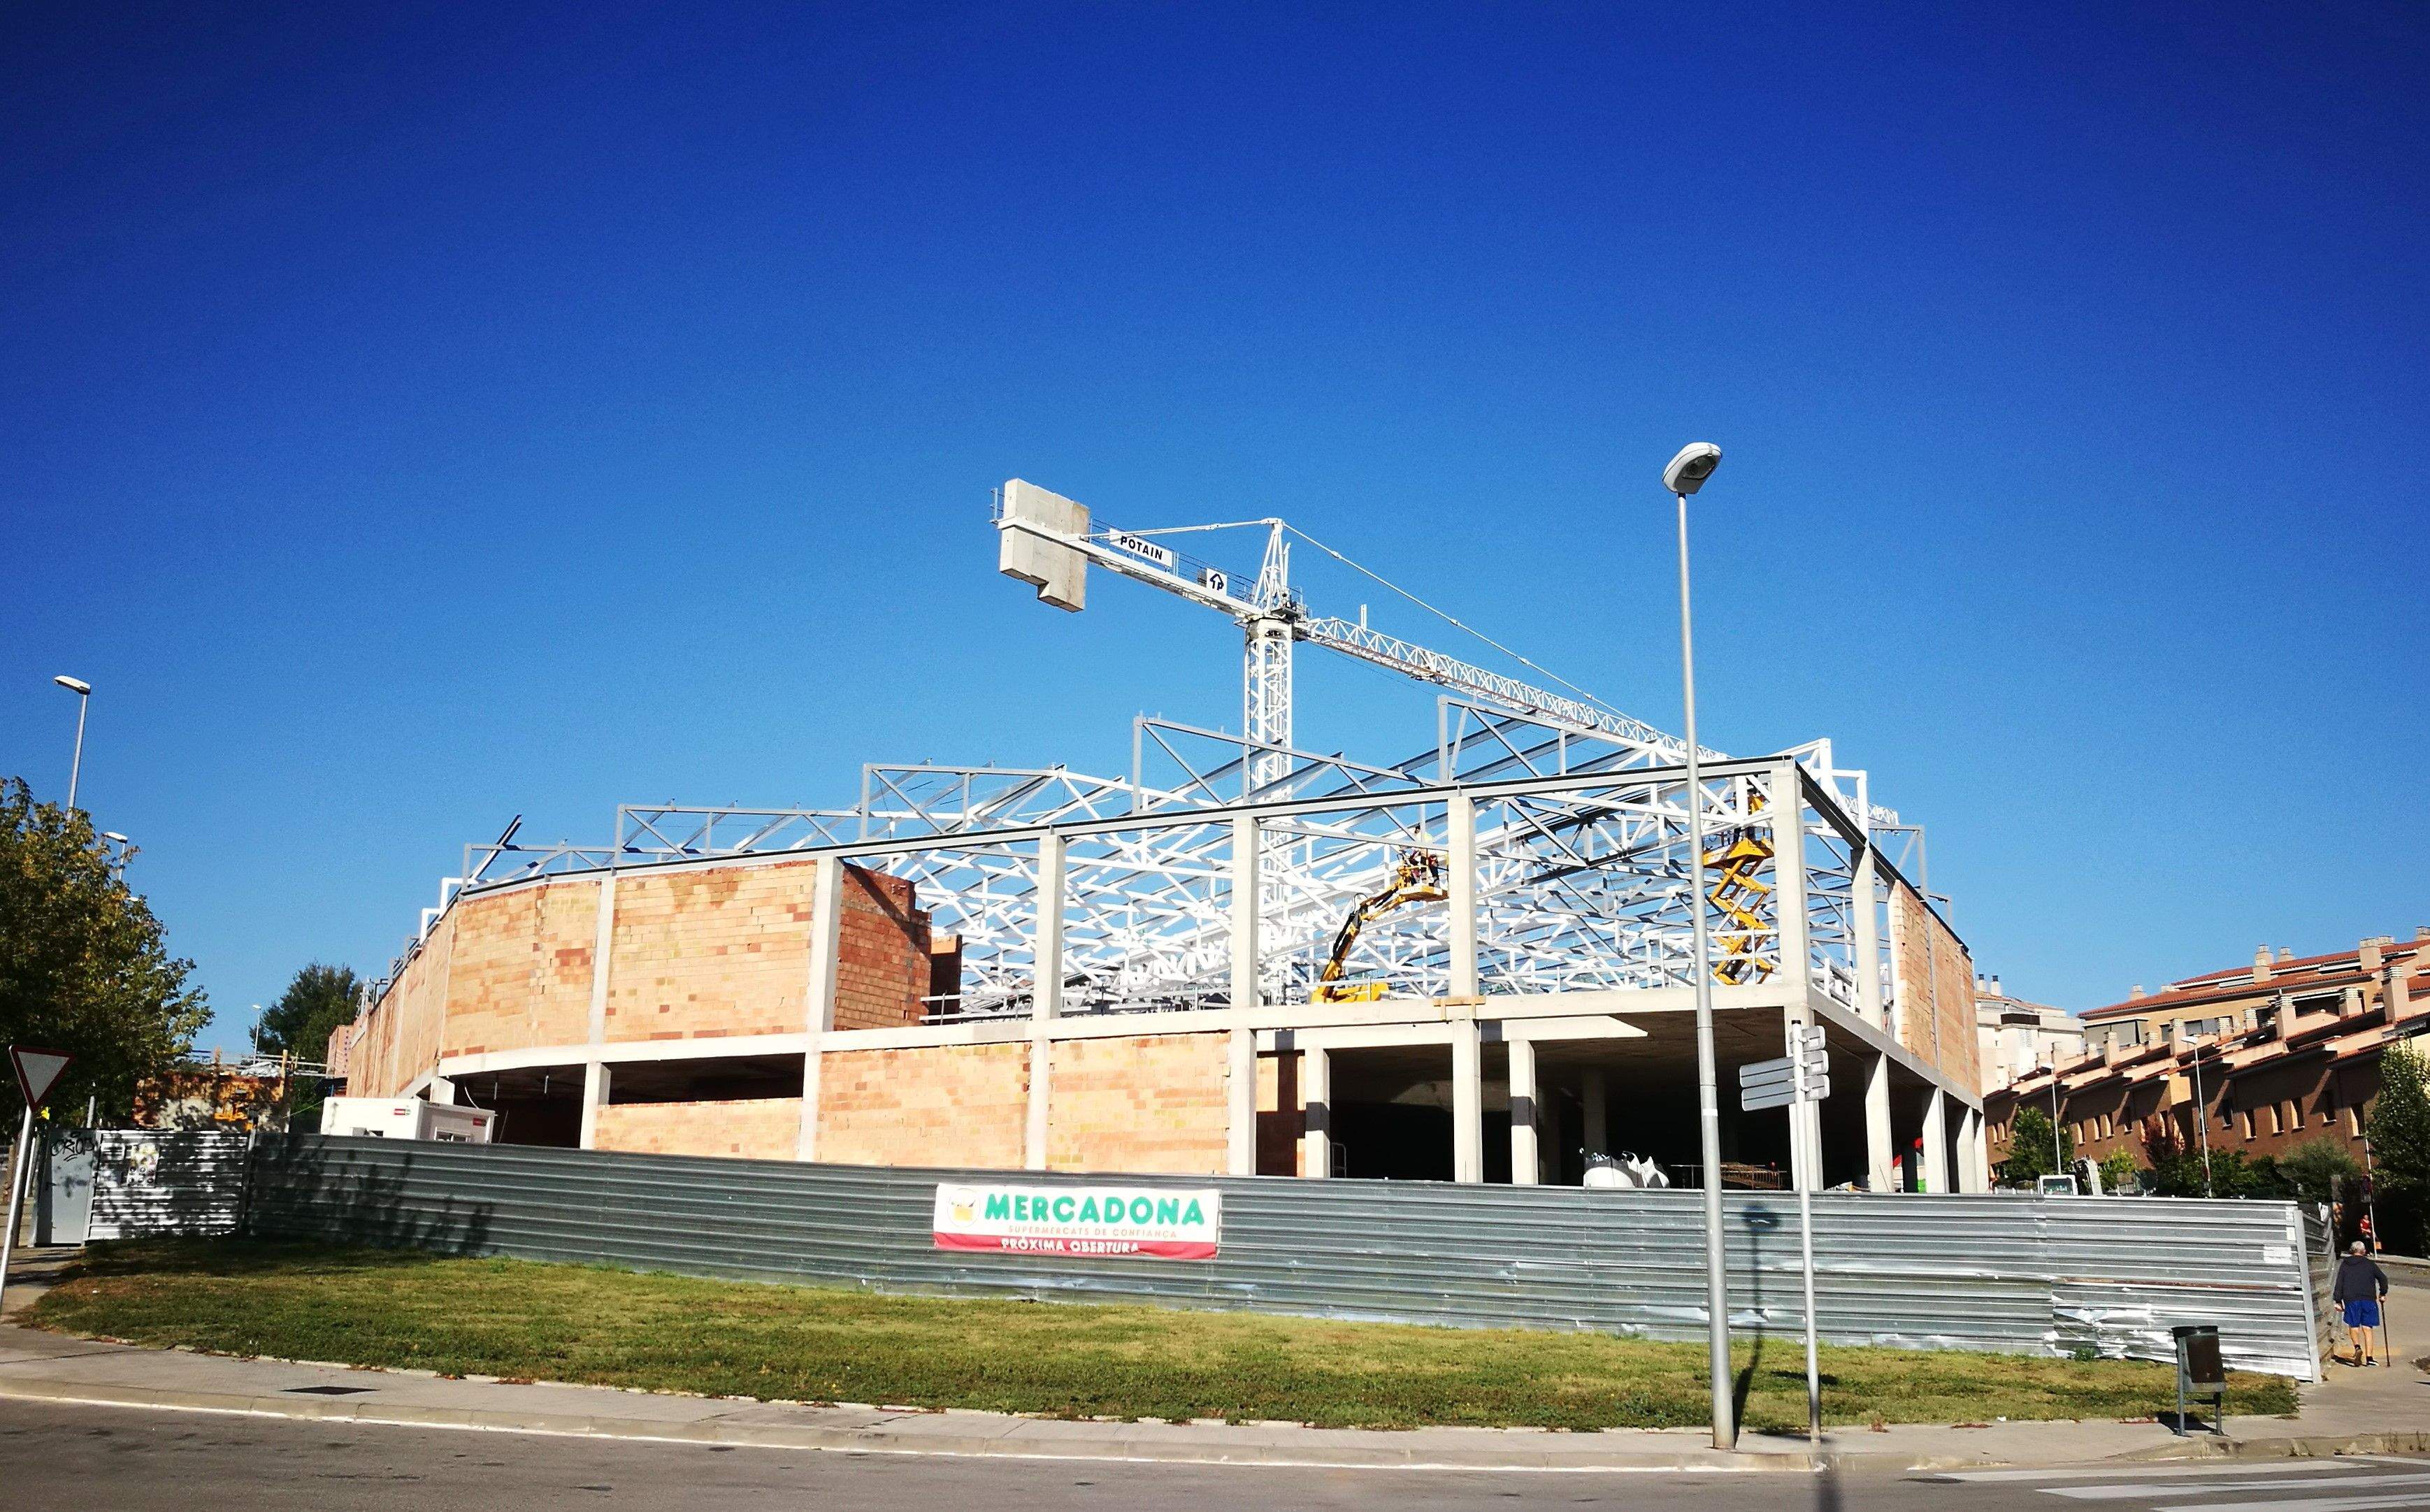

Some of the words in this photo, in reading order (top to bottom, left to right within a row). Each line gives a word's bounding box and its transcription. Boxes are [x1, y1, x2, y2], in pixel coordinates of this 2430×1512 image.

[1120, 535, 1163, 560] POTAIN
[984, 1193, 1205, 1225] MERCADONA
[1008, 1225, 1089, 1236] SUPERMERCATS
[1095, 1227, 1107, 1236] DE
[1113, 1228, 1177, 1239] CONFIANÇA
[1070, 1239, 1139, 1254] OBERTURA
